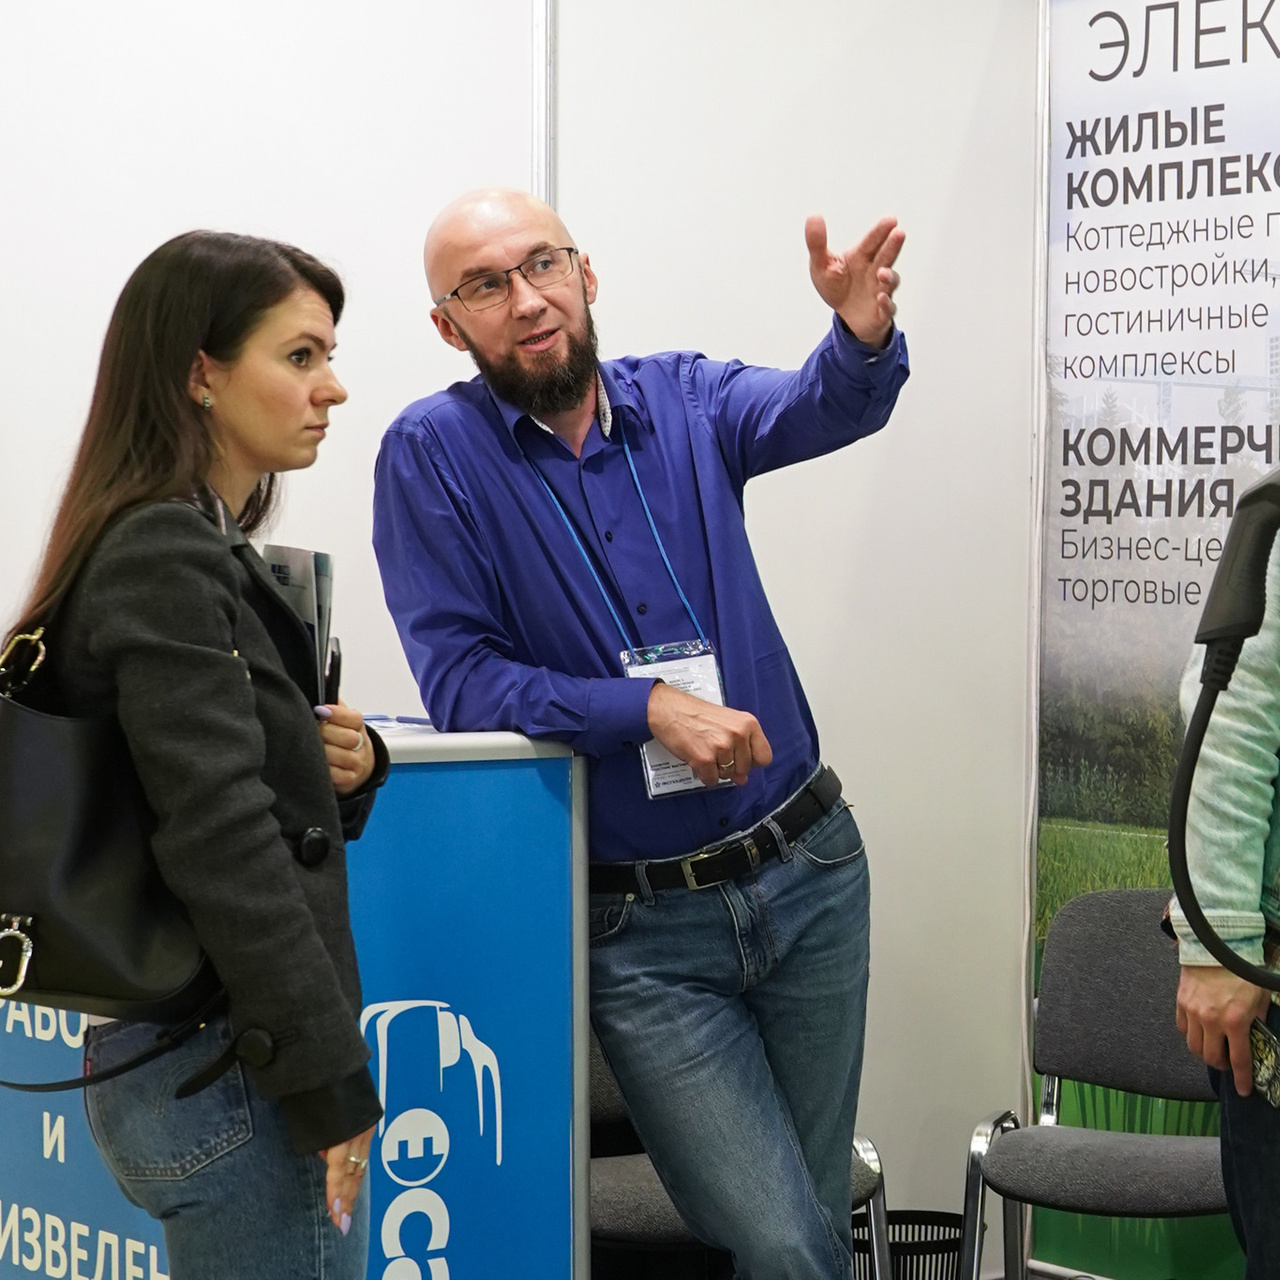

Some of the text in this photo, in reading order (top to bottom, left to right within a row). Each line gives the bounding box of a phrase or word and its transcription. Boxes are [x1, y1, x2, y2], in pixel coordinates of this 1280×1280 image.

[1066, 103, 1226, 160] ЖИЛЫЕ
[1066, 212, 1255, 253] Коттеджные
[1065, 248, 1278, 297] новостройки,
[1064, 302, 1269, 337] гостиничные
[1063, 348, 1236, 380] комплексы
[1060, 478, 1235, 524] ЗДАНИЯ
[1060, 529, 1223, 567] Бизнес-це
[1058, 577, 1202, 610] торговые
[43, 1110, 65, 1163] И
